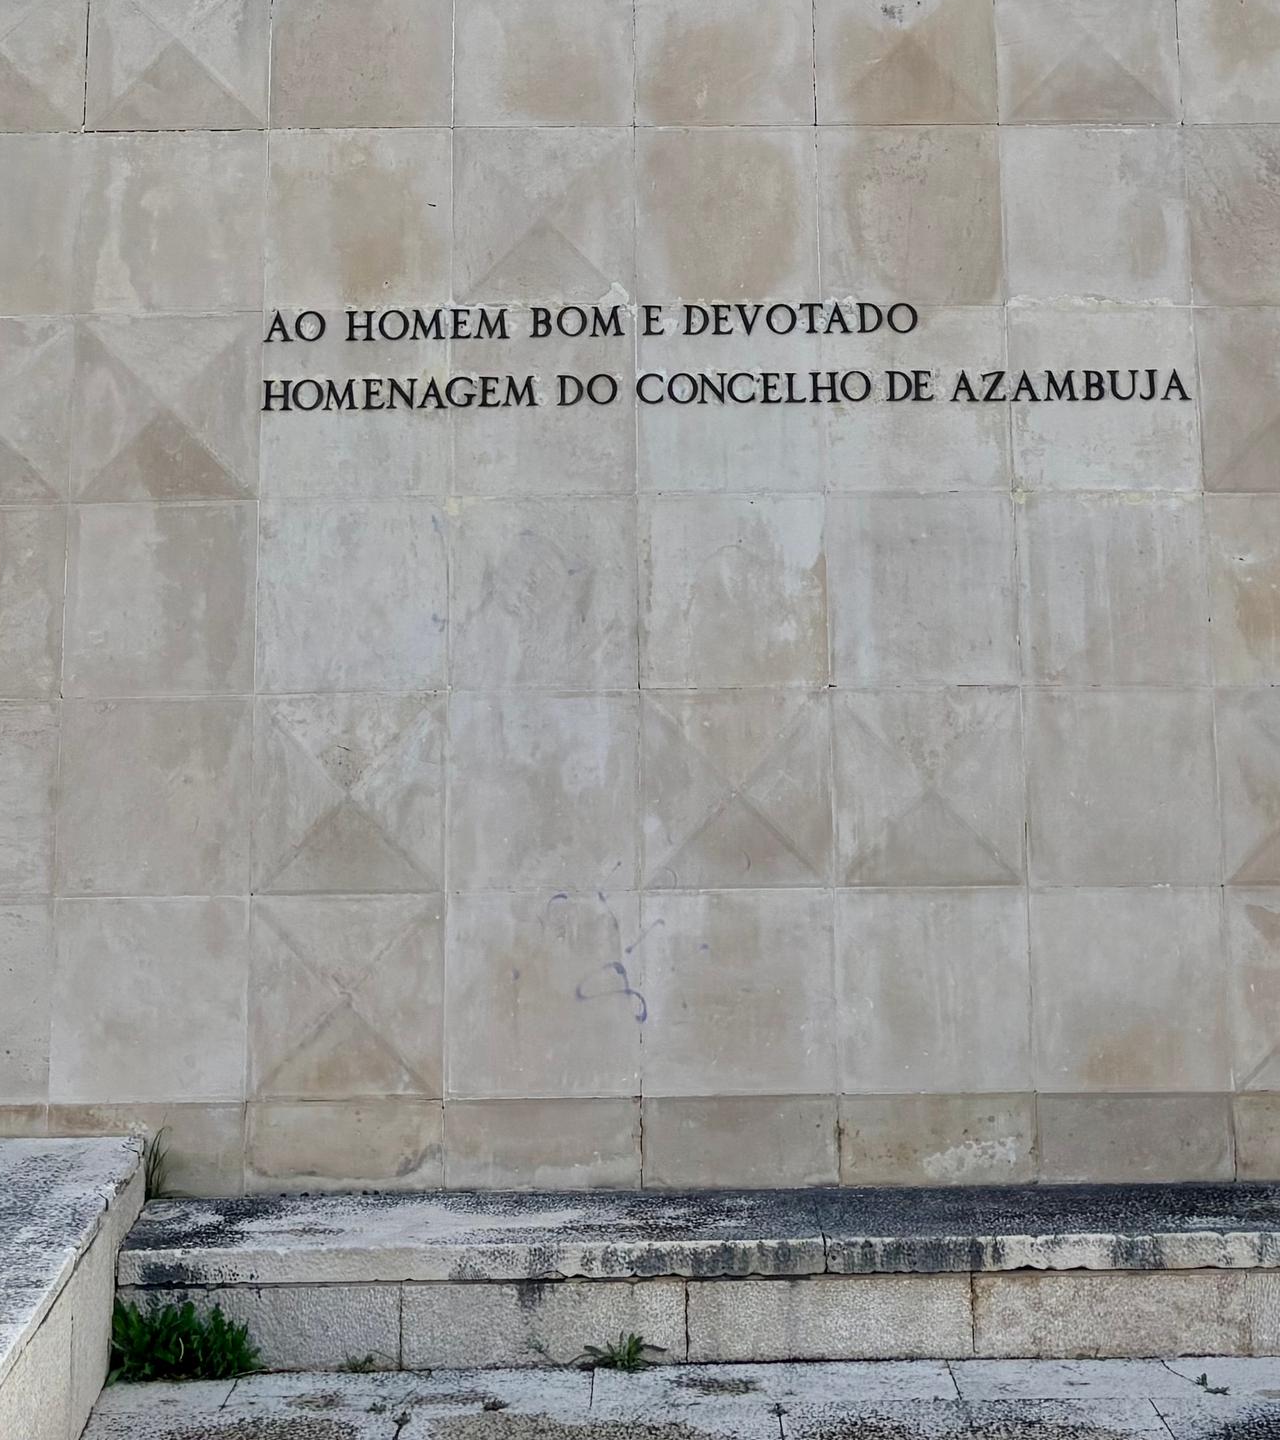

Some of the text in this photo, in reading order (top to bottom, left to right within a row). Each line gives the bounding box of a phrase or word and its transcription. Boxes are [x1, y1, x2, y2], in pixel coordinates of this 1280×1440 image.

[263, 302, 918, 343] AO HOMEM BOM E DEVOTADO
[260, 368, 1191, 411] HOMENAGEM DO CONCELHO DE AZAMBUJA
